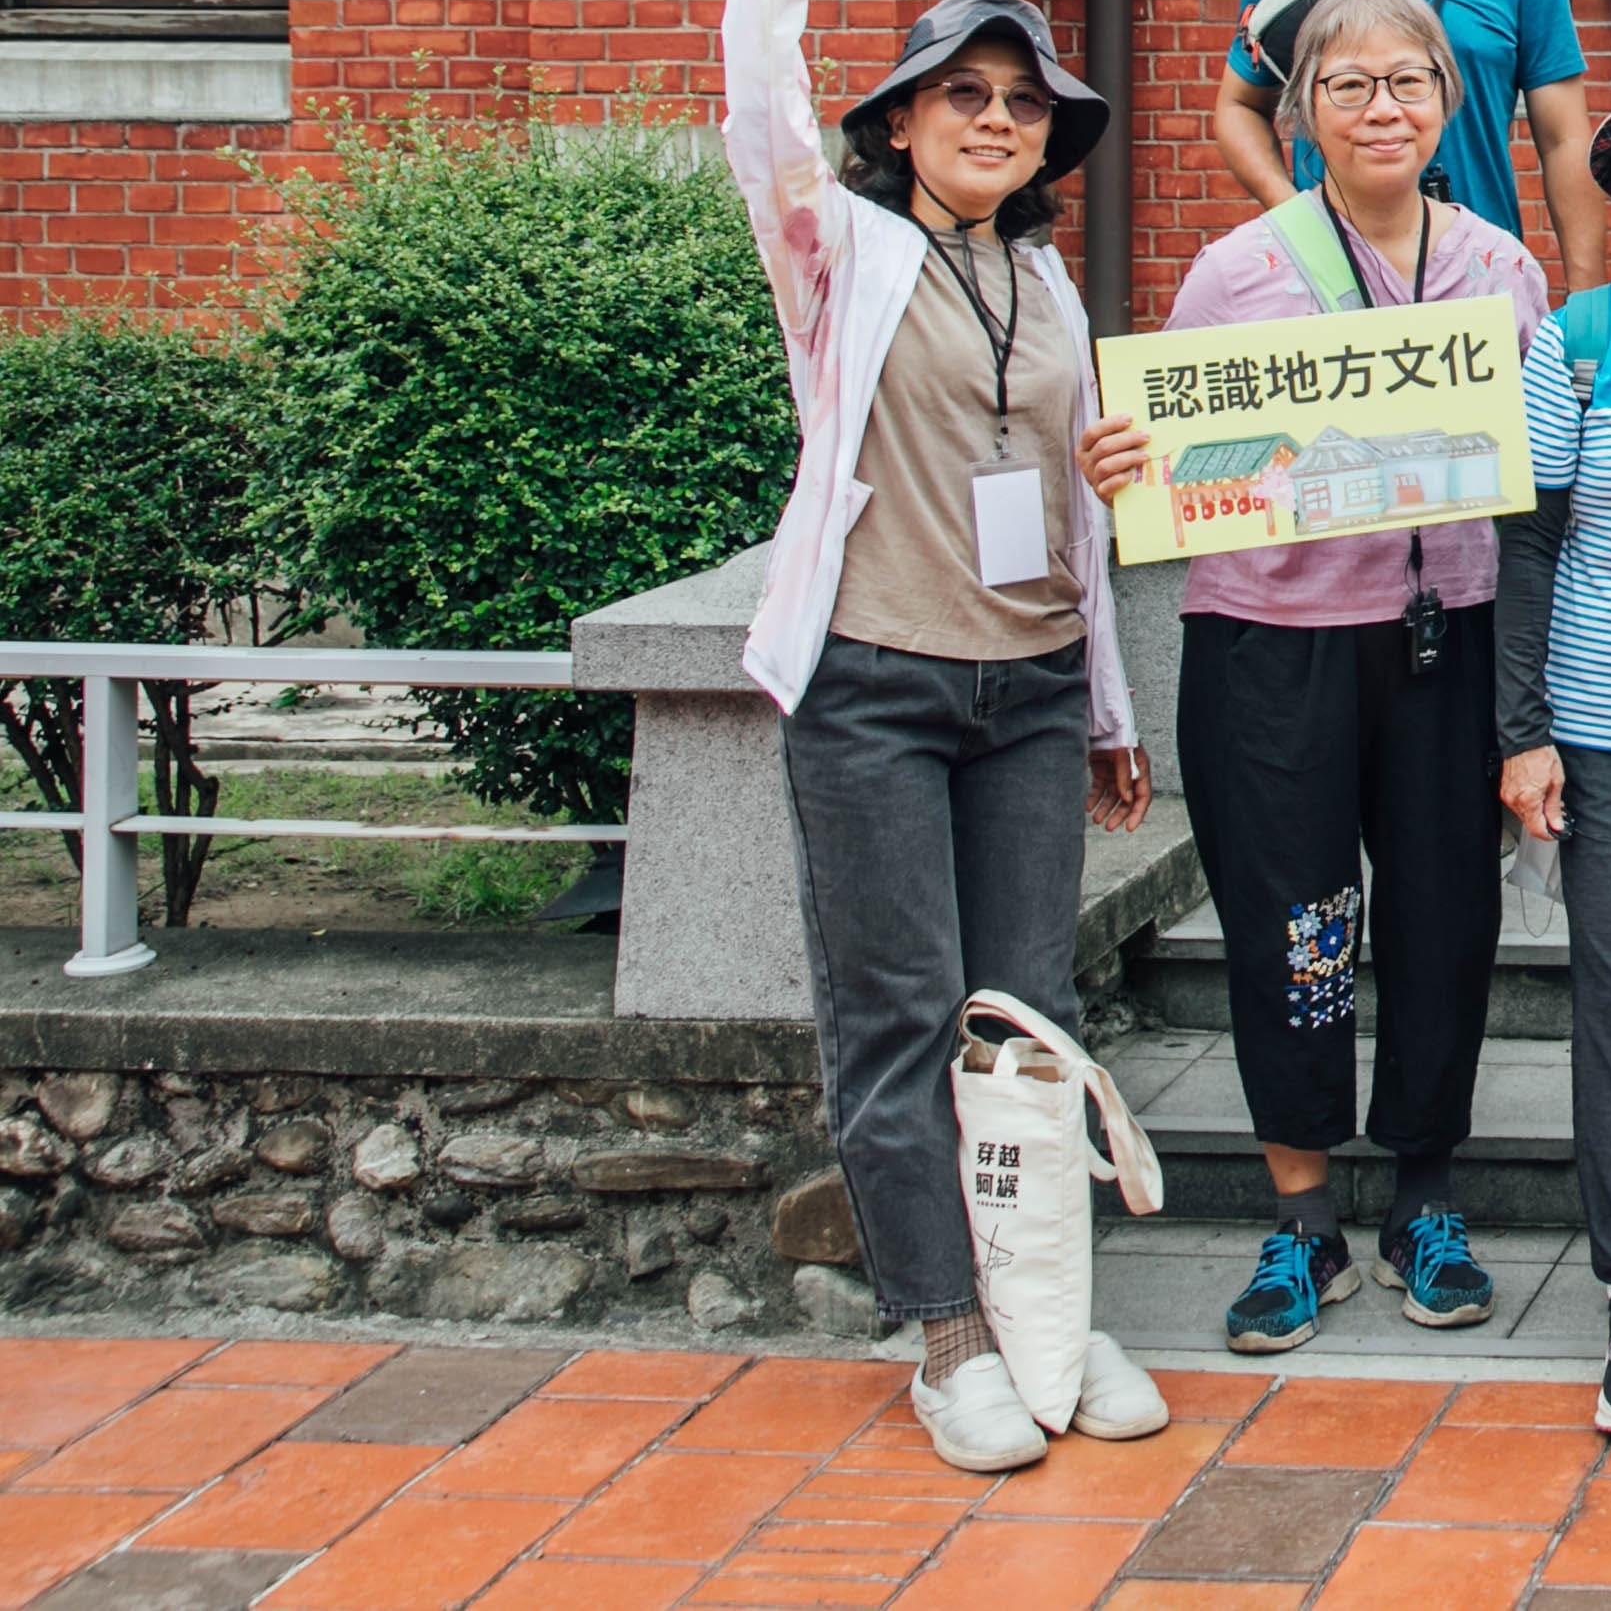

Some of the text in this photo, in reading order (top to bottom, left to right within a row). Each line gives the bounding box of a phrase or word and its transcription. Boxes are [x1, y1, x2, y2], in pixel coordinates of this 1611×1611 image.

[1142, 332, 1495, 422] 認識地方文化
[977, 1141, 1021, 1168] 穿越
